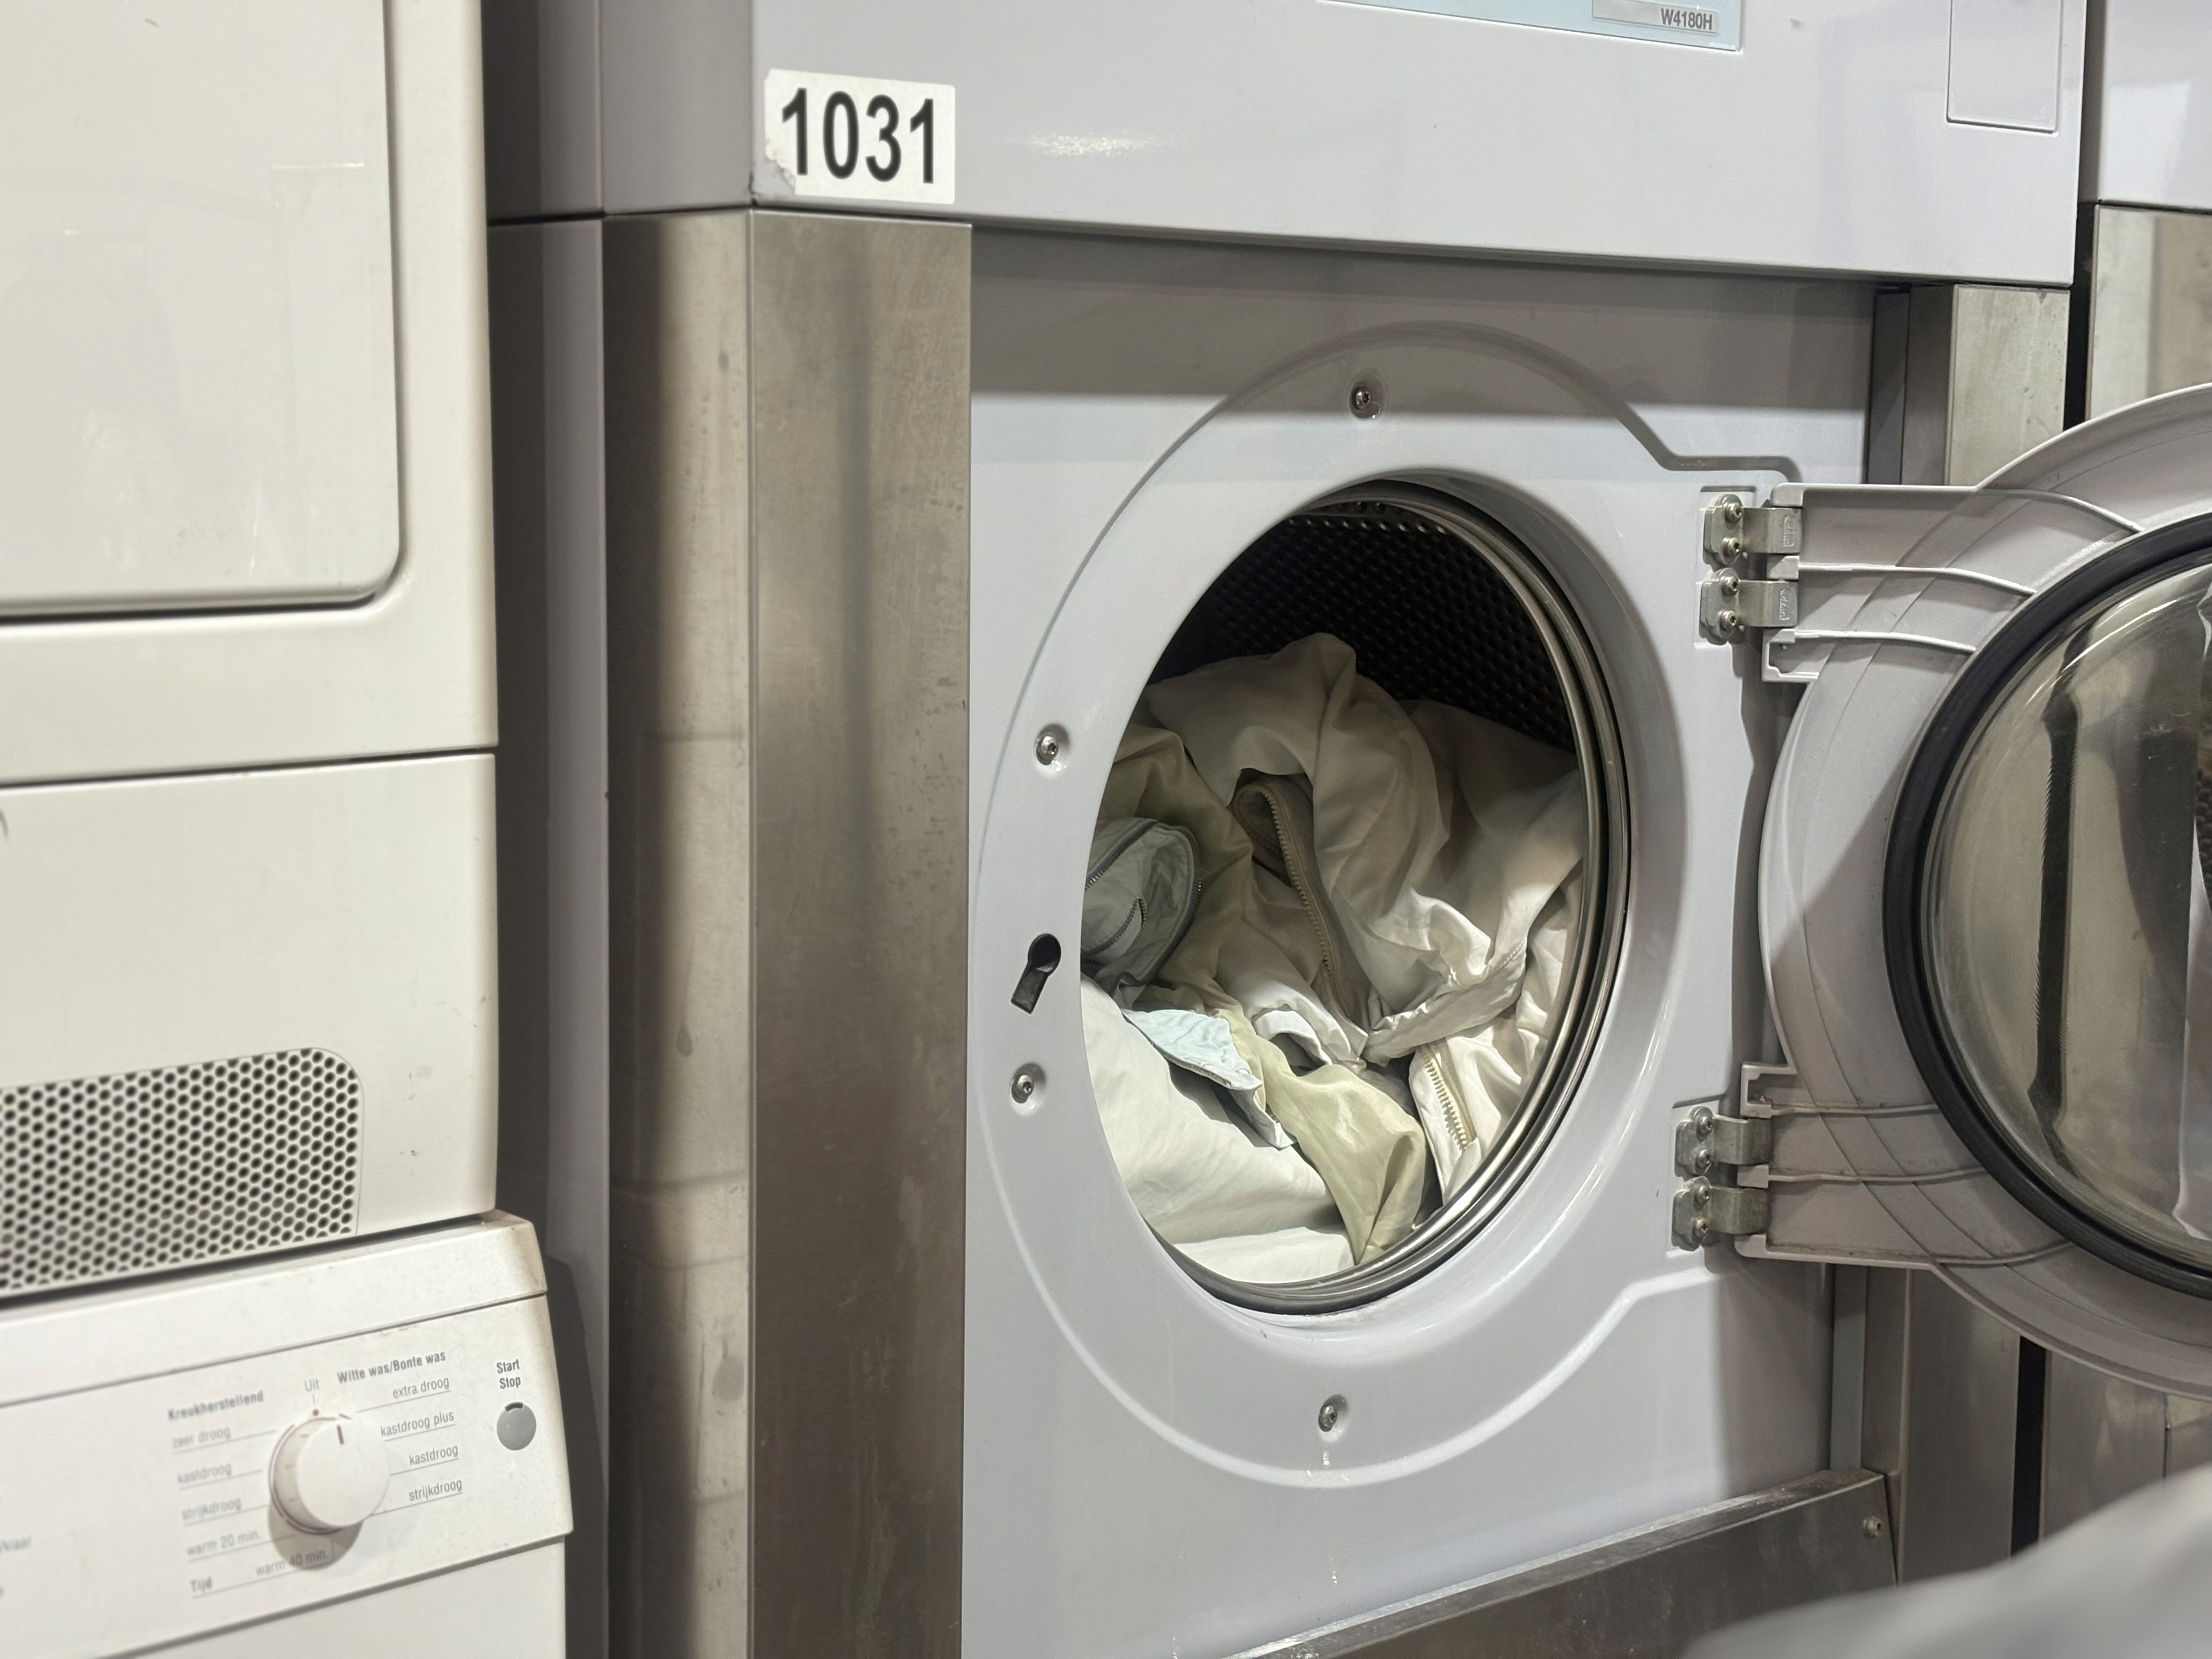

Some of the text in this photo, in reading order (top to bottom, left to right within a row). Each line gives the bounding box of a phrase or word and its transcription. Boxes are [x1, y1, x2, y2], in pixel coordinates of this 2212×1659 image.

[1660, 8, 1712, 30] W4180H
[782, 87, 934, 184] 1031
[337, 1351, 446, 1384] Witte was/Bonte was
[496, 1359, 521, 1374] Start
[304, 1379, 320, 1392] Uit
[392, 1376, 450, 1399] extra droog
[499, 1375, 522, 1390] Stop
[167, 1391, 264, 1421] Kreukherstellend
[380, 1410, 455, 1437] kastdroog plus
[172, 1427, 231, 1448] zeer droog
[409, 1444, 459, 1466] kastdroog
[177, 1463, 232, 1485] kastdroog
[409, 1479, 462, 1502] strijkdroog
[182, 1498, 242, 1522] strijkdroog
[187, 1530, 262, 1557] warm 20 min.
[256, 1548, 328, 1576] warm 40 min.
[190, 1578, 213, 1593] Tijd
